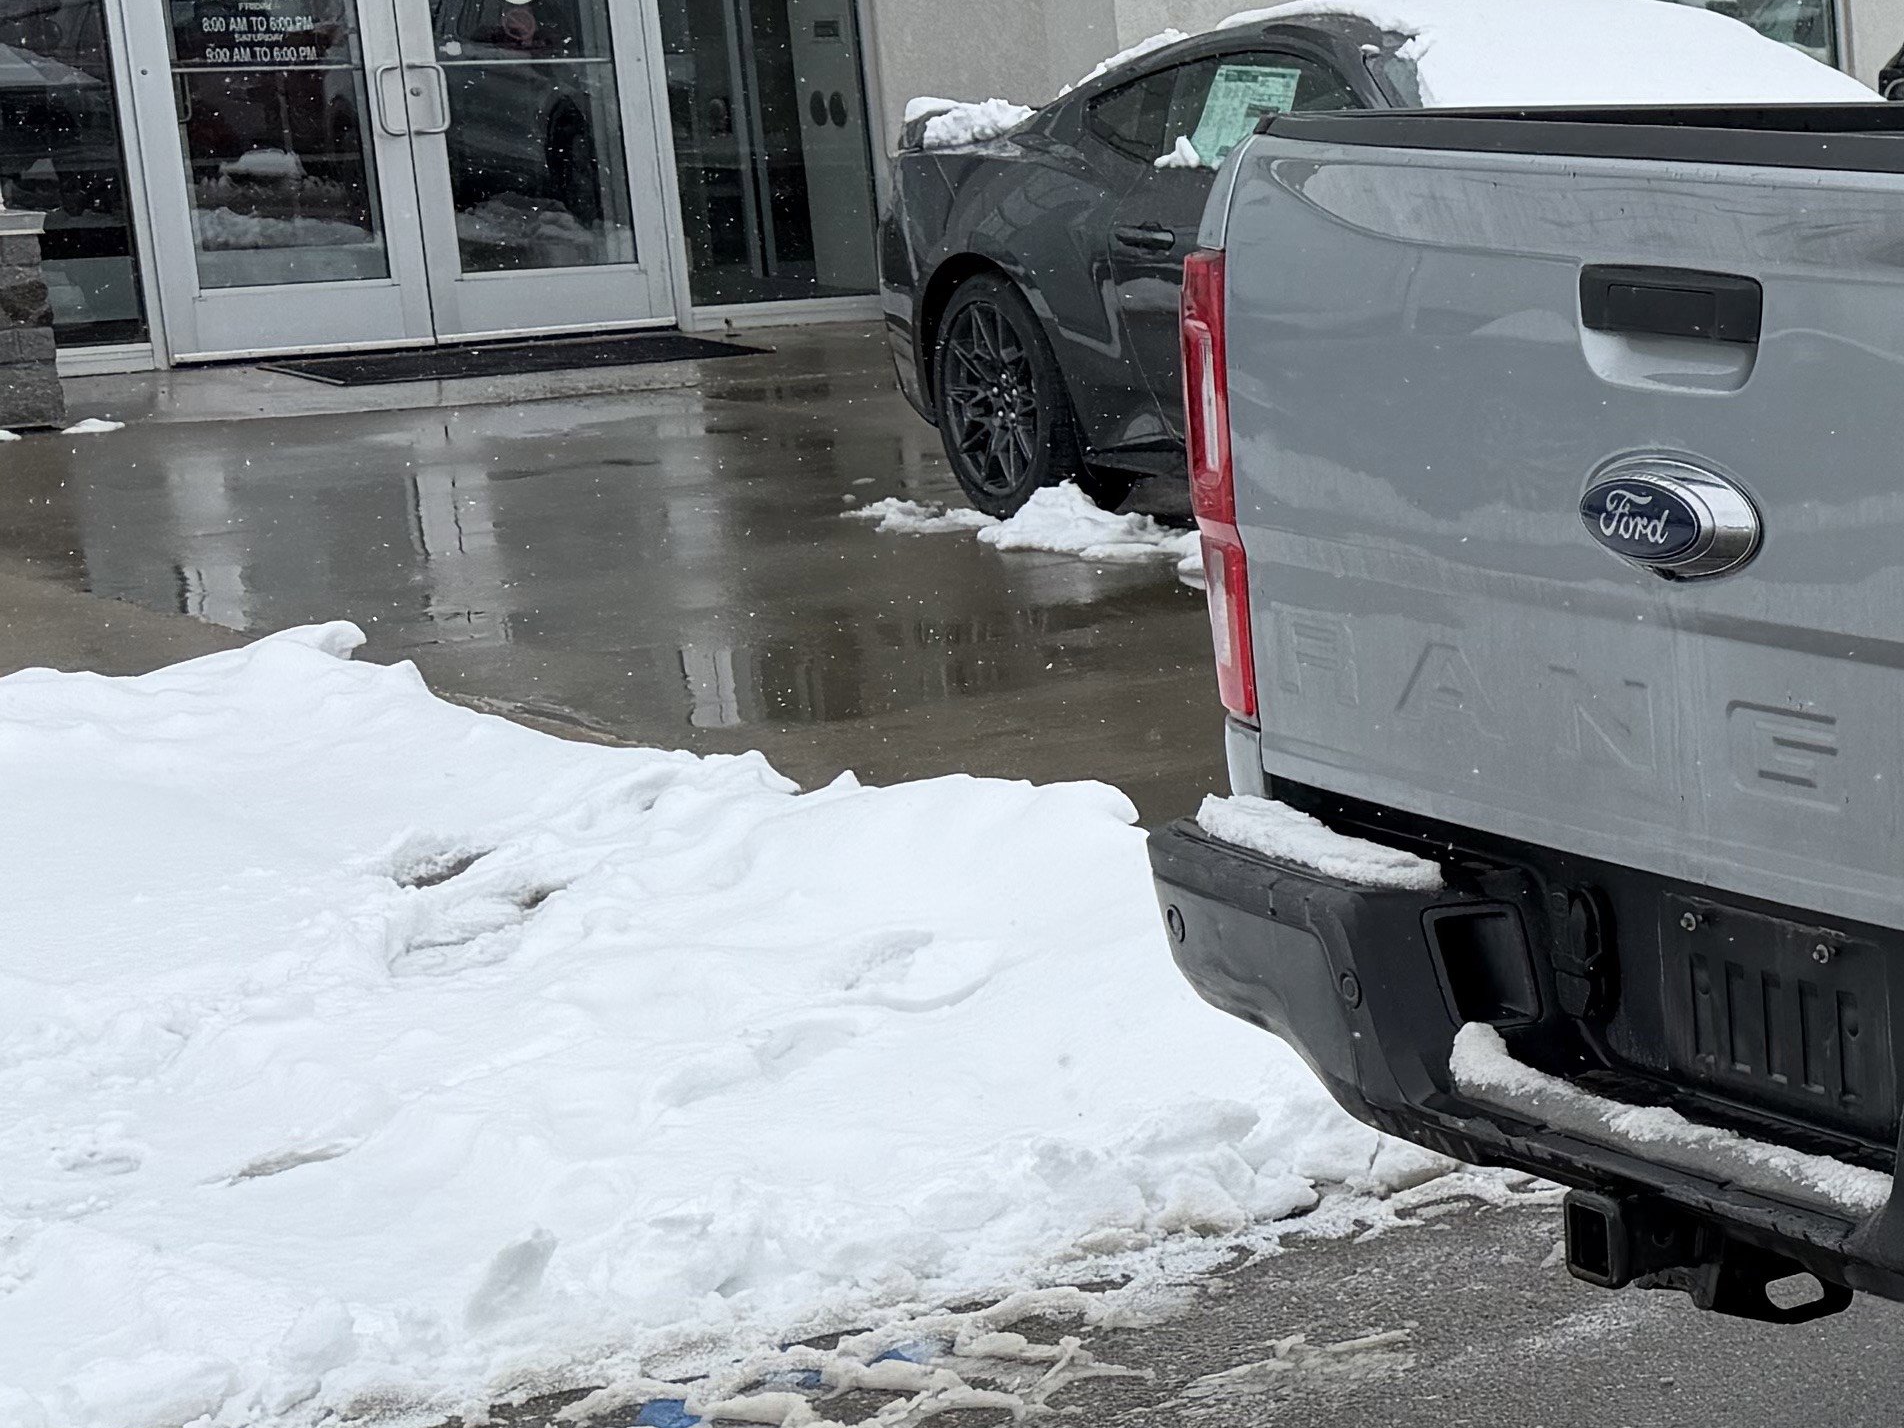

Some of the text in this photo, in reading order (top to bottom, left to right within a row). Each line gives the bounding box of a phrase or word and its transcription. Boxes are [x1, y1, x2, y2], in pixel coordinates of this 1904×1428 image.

[229, 17, 248, 32] AM
[250, 17, 267, 31] TO
[295, 15, 314, 31] PM
[233, 47, 251, 62] AM
[253, 47, 270, 62] TO
[299, 46, 318, 61] PM
[1599, 488, 1671, 545] Ford
